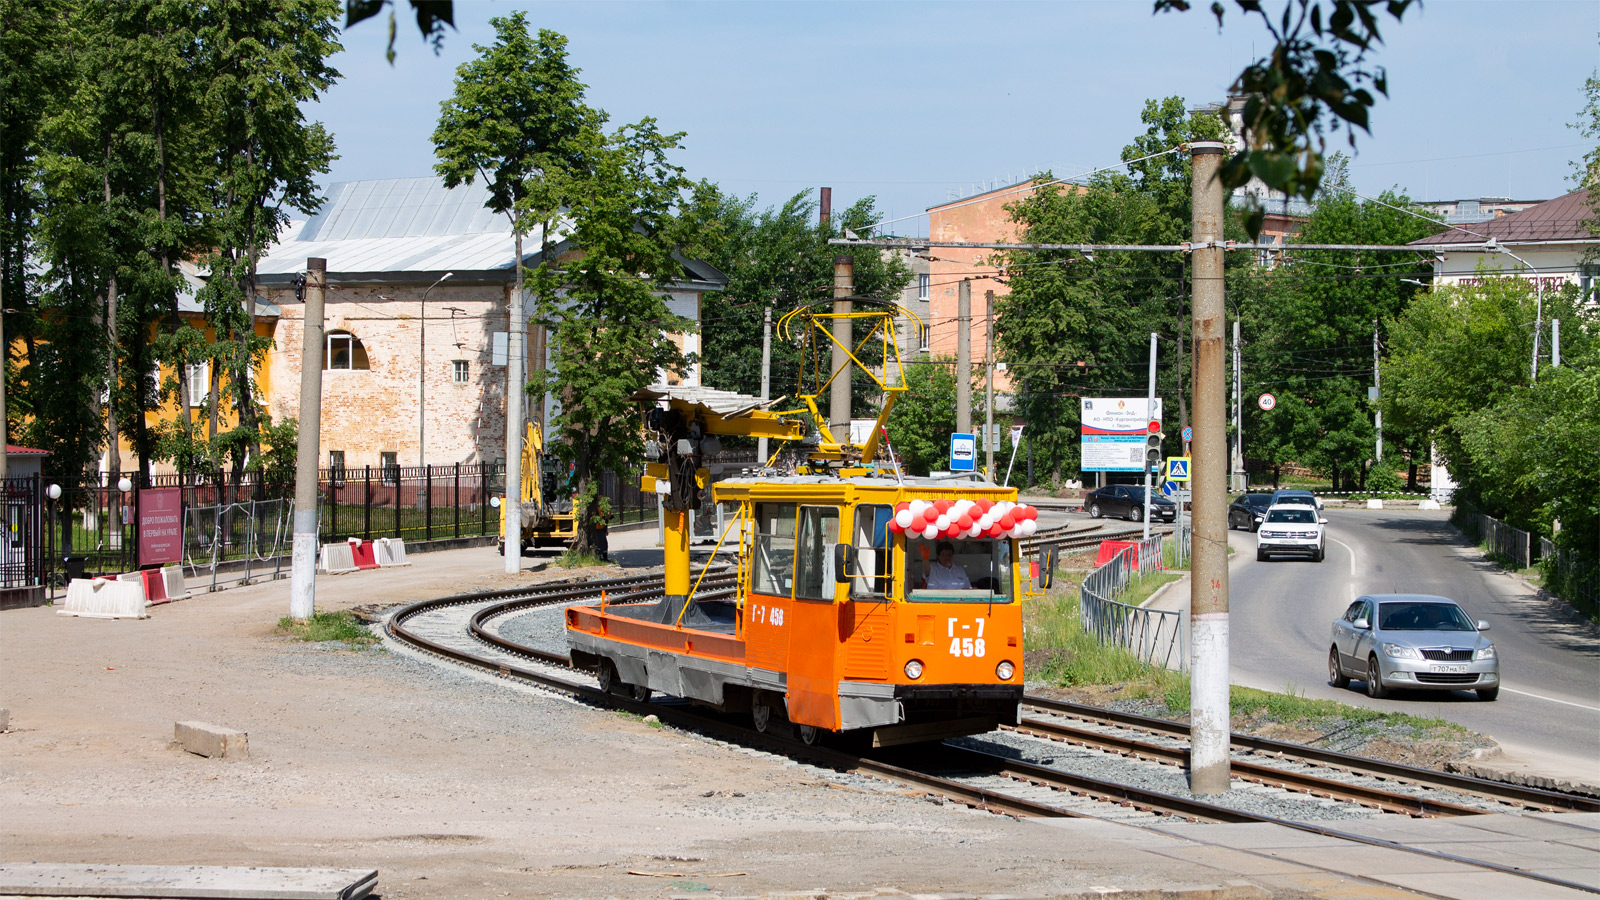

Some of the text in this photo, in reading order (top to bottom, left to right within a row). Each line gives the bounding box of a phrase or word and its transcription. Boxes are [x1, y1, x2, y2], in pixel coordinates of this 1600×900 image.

[1263, 398, 1272, 406] 40
[142, 515, 178, 526] ДОБРО ПОЖАЛОВАТЬ
[770, 607, 784, 626] 458
[949, 637, 986, 657] 458
